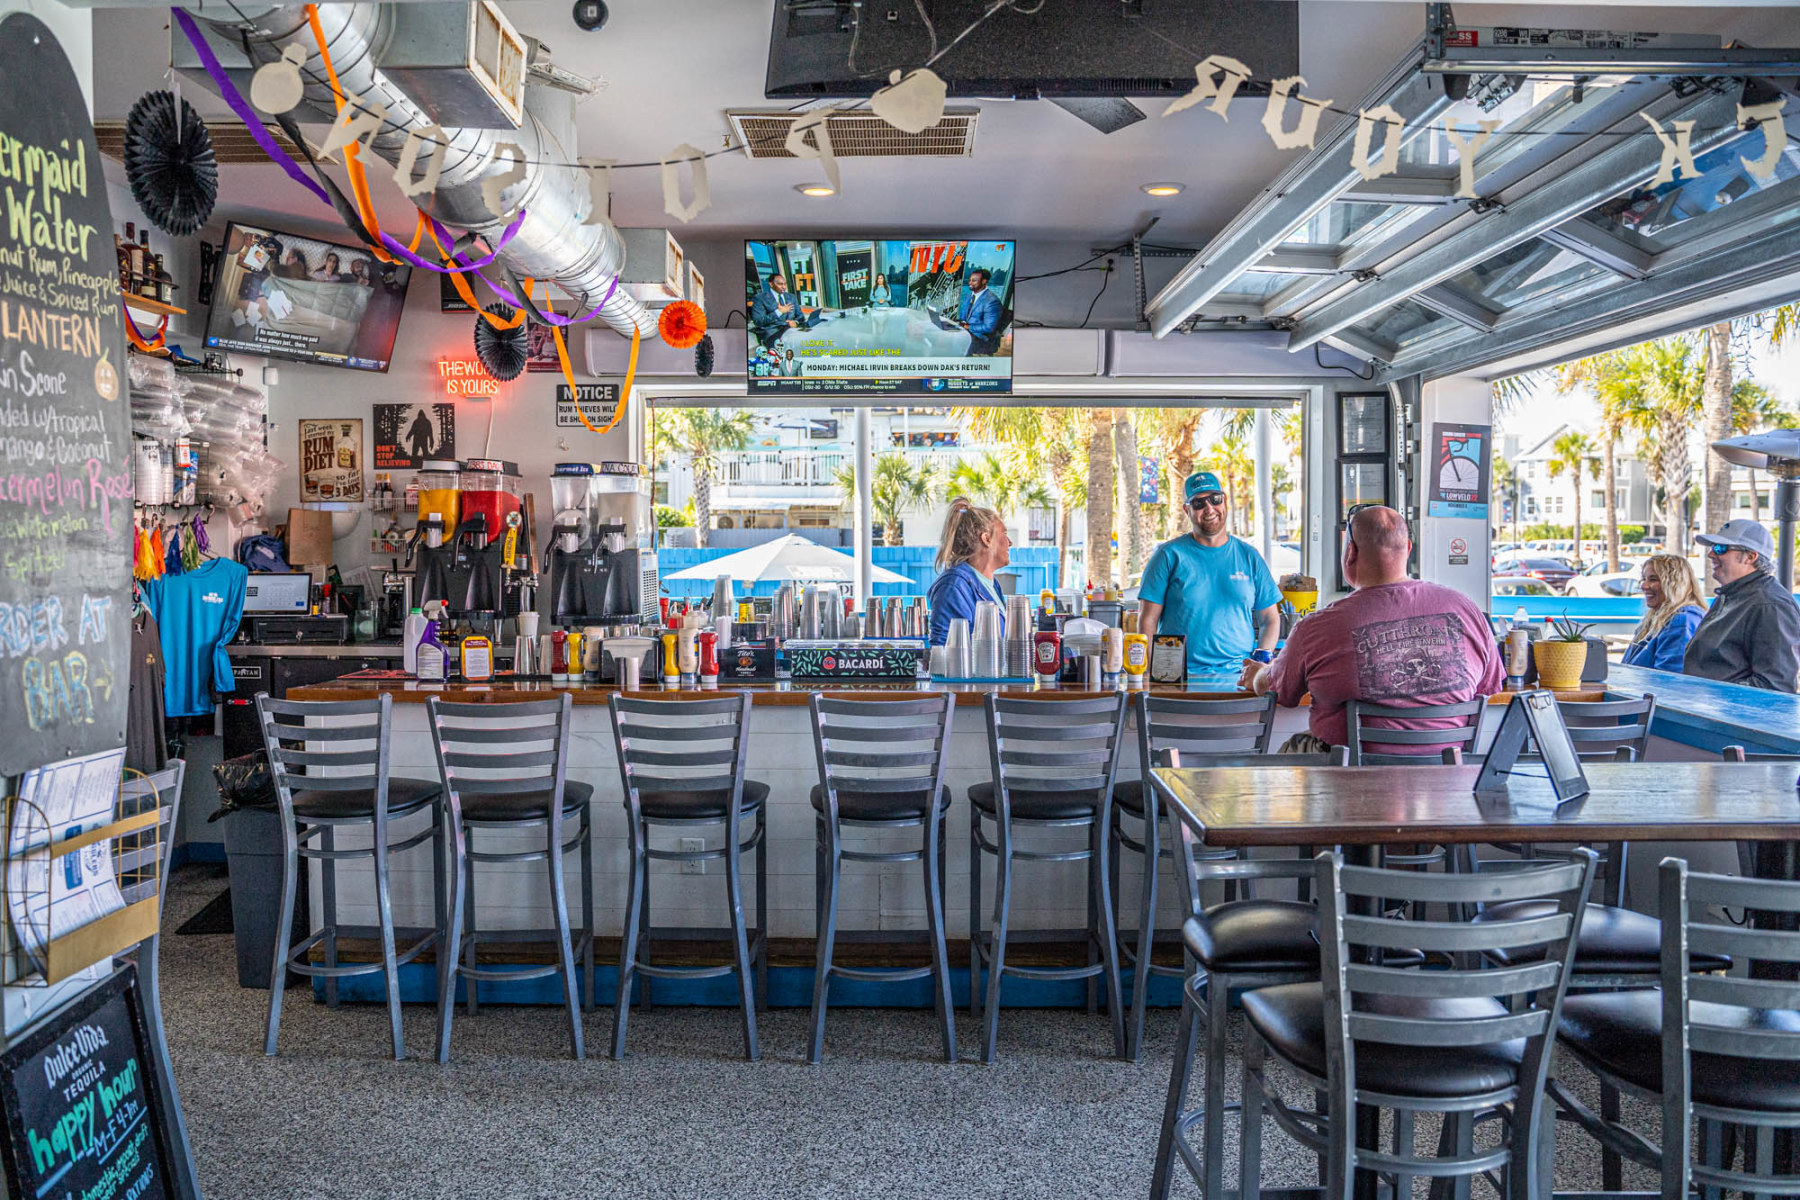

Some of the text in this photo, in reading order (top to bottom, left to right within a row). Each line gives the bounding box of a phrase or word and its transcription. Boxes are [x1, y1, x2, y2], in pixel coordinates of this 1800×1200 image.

[5, 186, 98, 262] Water
[910, 241, 968, 274] NYC
[62, 257, 121, 302] Pineapple
[795, 274, 814, 291] FT
[842, 268, 868, 282] FIRST
[843, 279, 867, 291] TAKE
[47, 283, 89, 312] Spiced
[91, 296, 119, 327] Rum
[800, 291, 817, 307] FT
[2, 300, 101, 358] LANTERN
[20, 350, 67, 397] Scone
[447, 379, 499, 394] IS YOURS
[563, 386, 613, 400] NOTICE
[559, 405, 573, 413] RUM
[56, 434, 113, 464] Coconut
[303, 435, 335, 456] RUM
[376, 444, 397, 452] DON'T
[303, 452, 335, 474] DIET
[336, 481, 361, 498] 3 DAYS
[78, 593, 112, 645] AT
[1376, 643, 1395, 655] HELL
[233, 668, 259, 677] PARTAN
[838, 656, 884, 669] BACARDÍ
[22, 651, 95, 732] BAR
[62, 1060, 107, 1103] TEQUILA
[27, 1058, 138, 1175] happy hour
